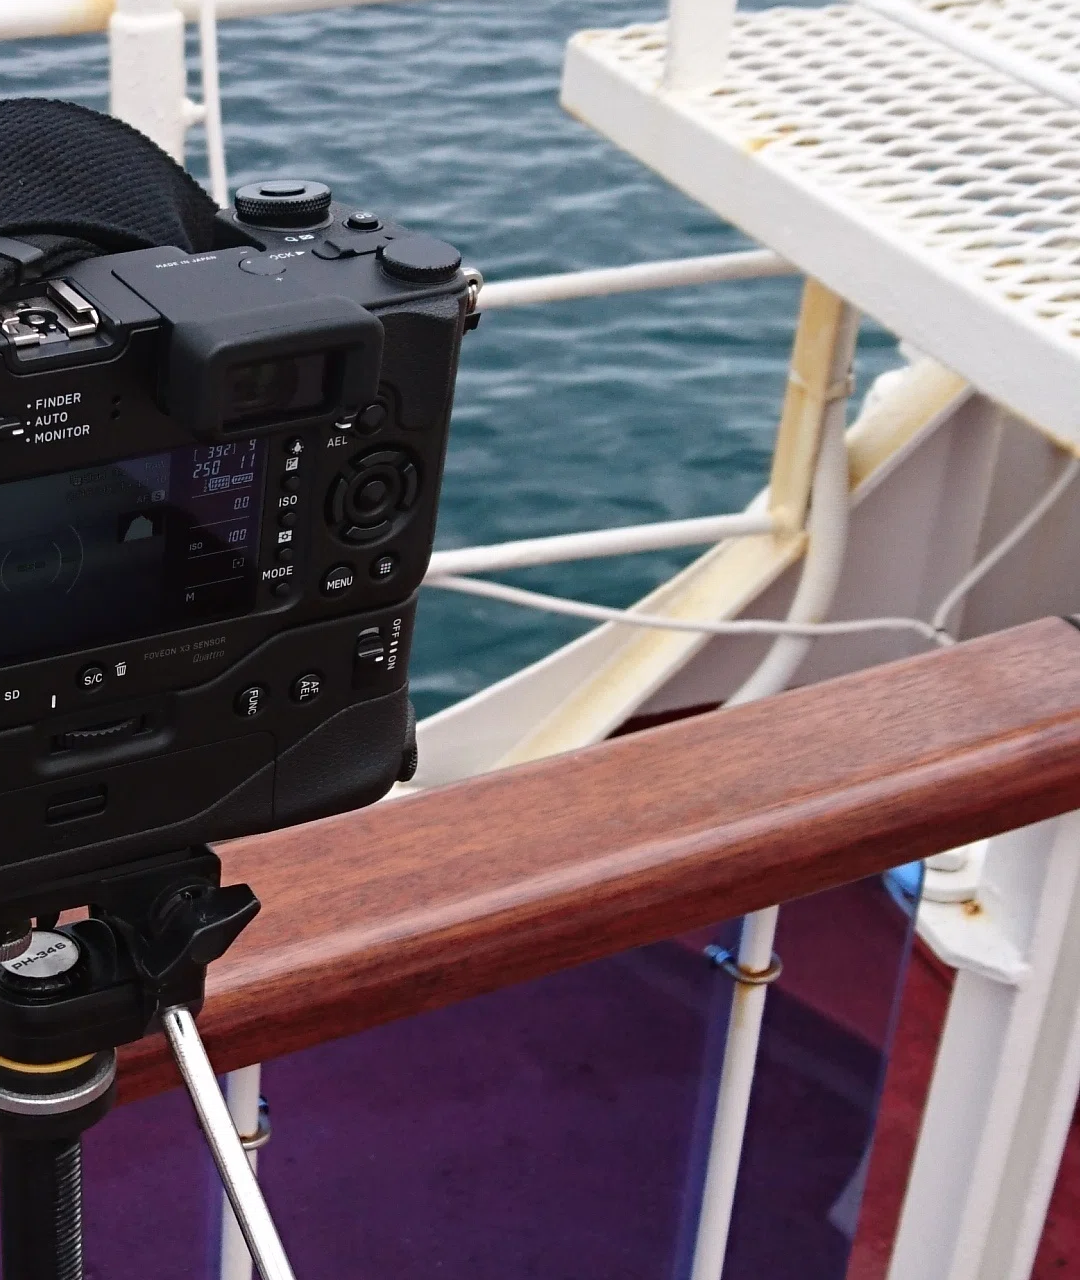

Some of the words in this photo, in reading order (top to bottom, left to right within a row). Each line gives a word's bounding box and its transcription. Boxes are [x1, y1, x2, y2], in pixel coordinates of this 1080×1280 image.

[35, 392, 82, 410] FINDER
[35, 411, 68, 426] AUTO
[34, 424, 90, 444] MONITOR
[326, 435, 348, 448] AEL
[192, 459, 221, 479] 250
[278, 495, 298, 508] ISO
[189, 541, 203, 551] ISO
[228, 528, 247, 543] 100
[262, 565, 294, 581] MODE
[326, 575, 354, 590] MENU
[185, 591, 195, 602] M
[391, 618, 402, 638] OFF
[143, 647, 177, 661] FOVEON
[179, 644, 190, 652] X3
[193, 636, 227, 650] SENSOR
[192, 650, 225, 663] Quattro
[387, 655, 397, 671] ON
[84, 673, 103, 686] S/C
[310, 681, 320, 694] AF
[4, 689, 21, 702] SD
[299, 681, 311, 701] AEL
[247, 689, 259, 716] FUNC
[11, 942, 67, 970] PH-346
